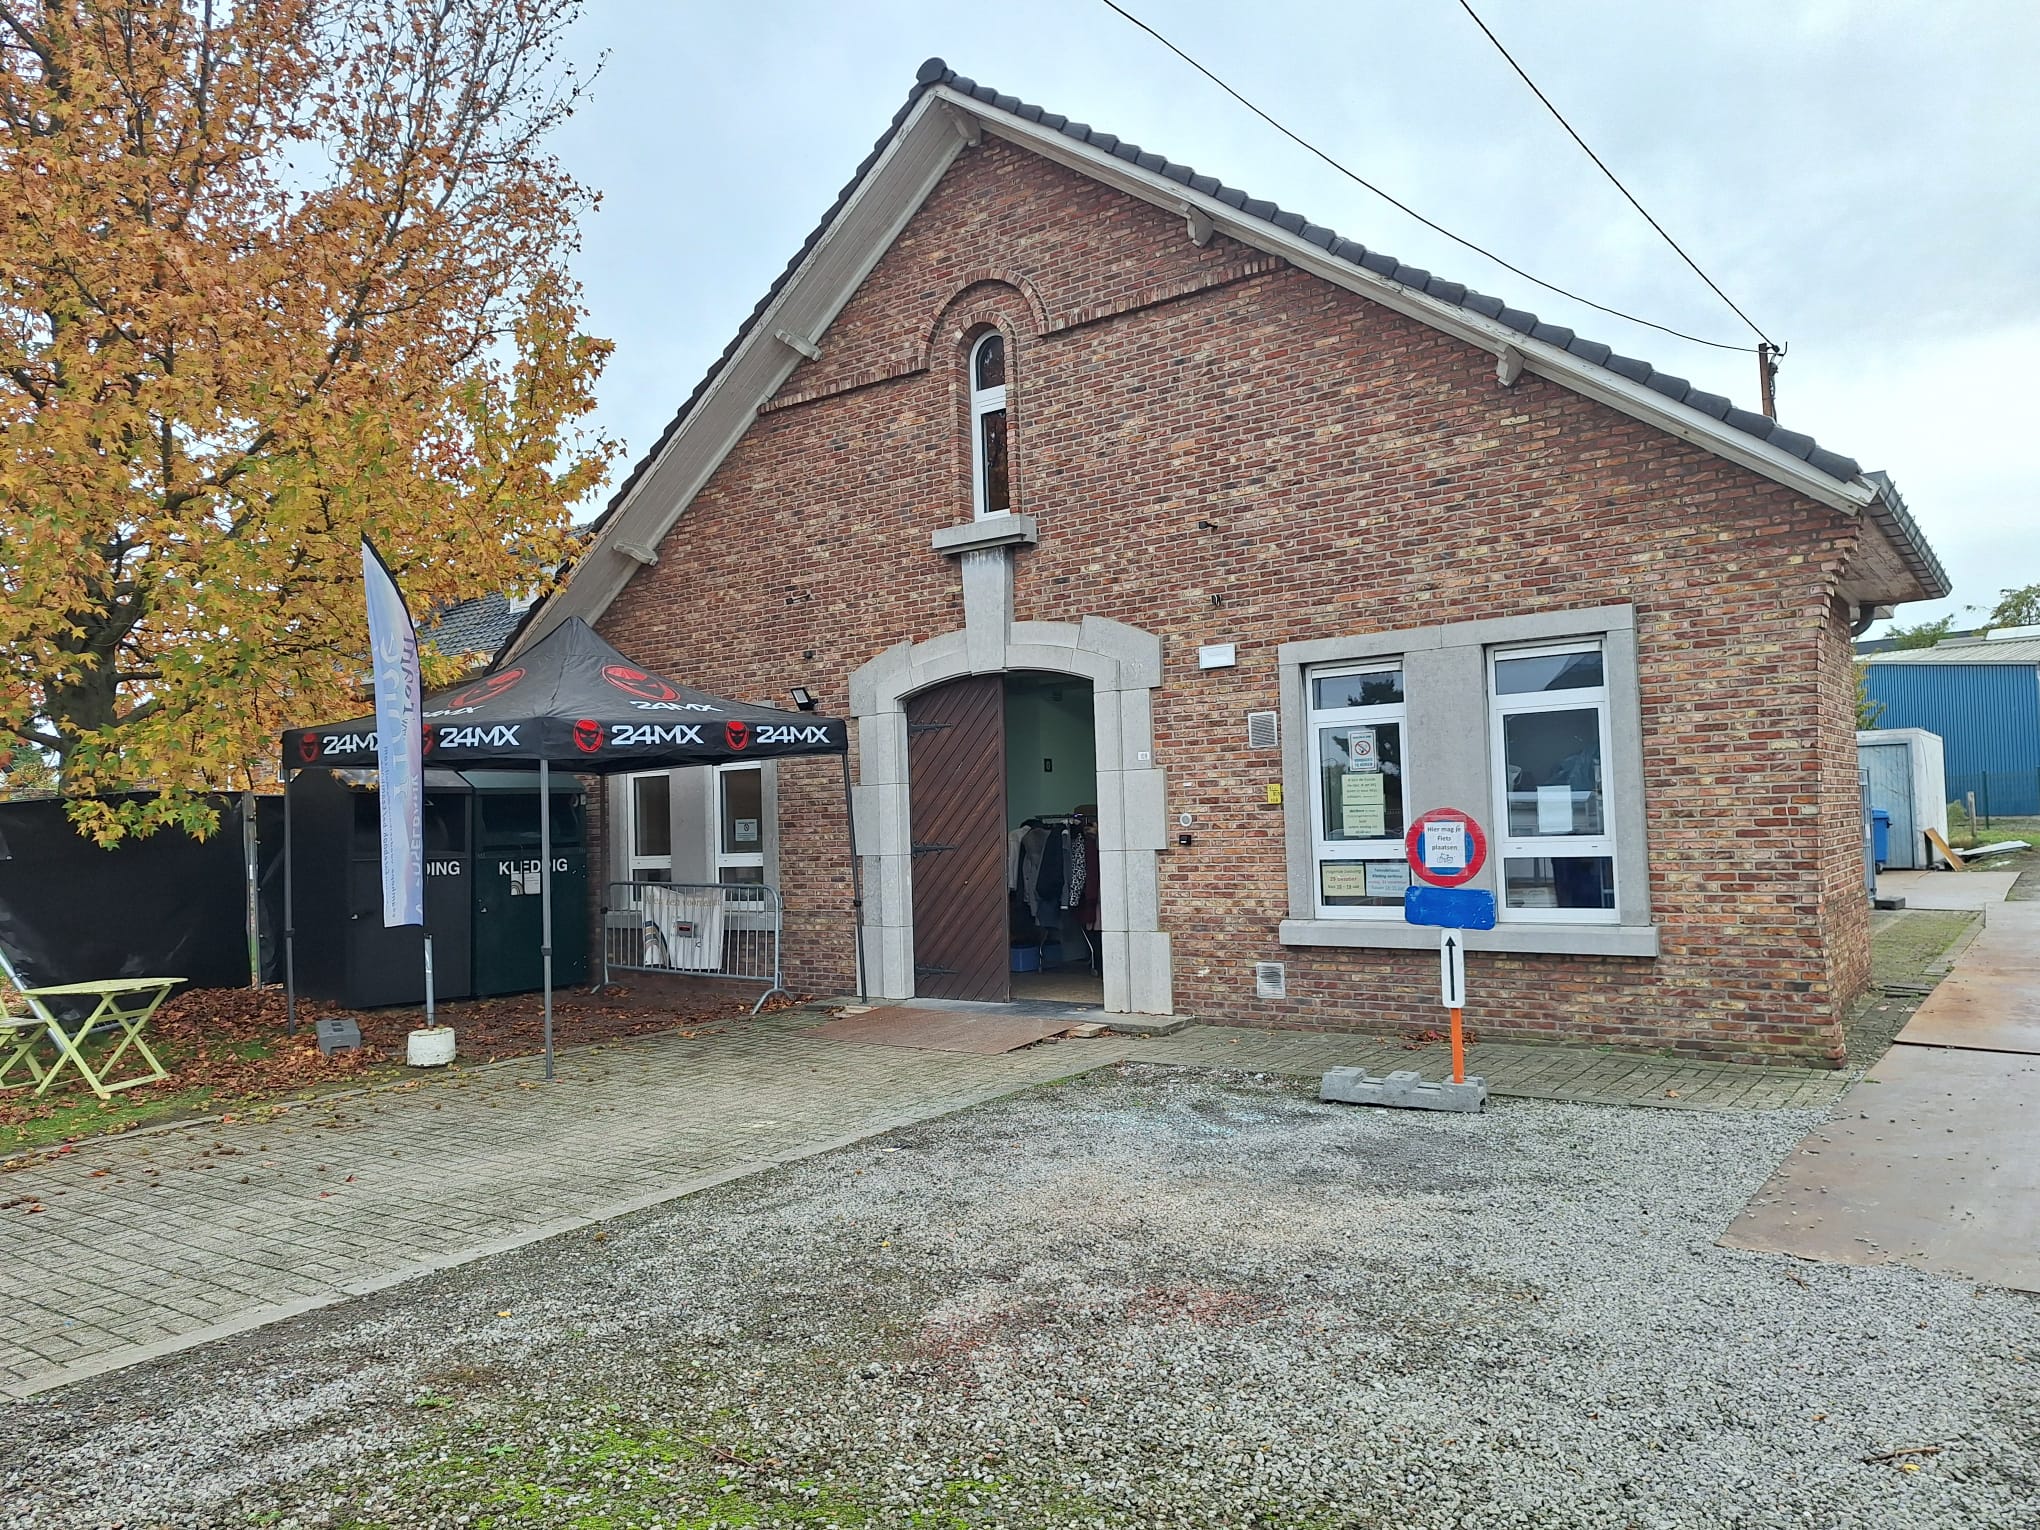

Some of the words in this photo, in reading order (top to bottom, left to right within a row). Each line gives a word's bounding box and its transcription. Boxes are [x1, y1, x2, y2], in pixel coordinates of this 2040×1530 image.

[440, 724, 520, 748] 24MX
[611, 724, 704, 745] 24MX
[756, 726, 831, 744] 24MX
